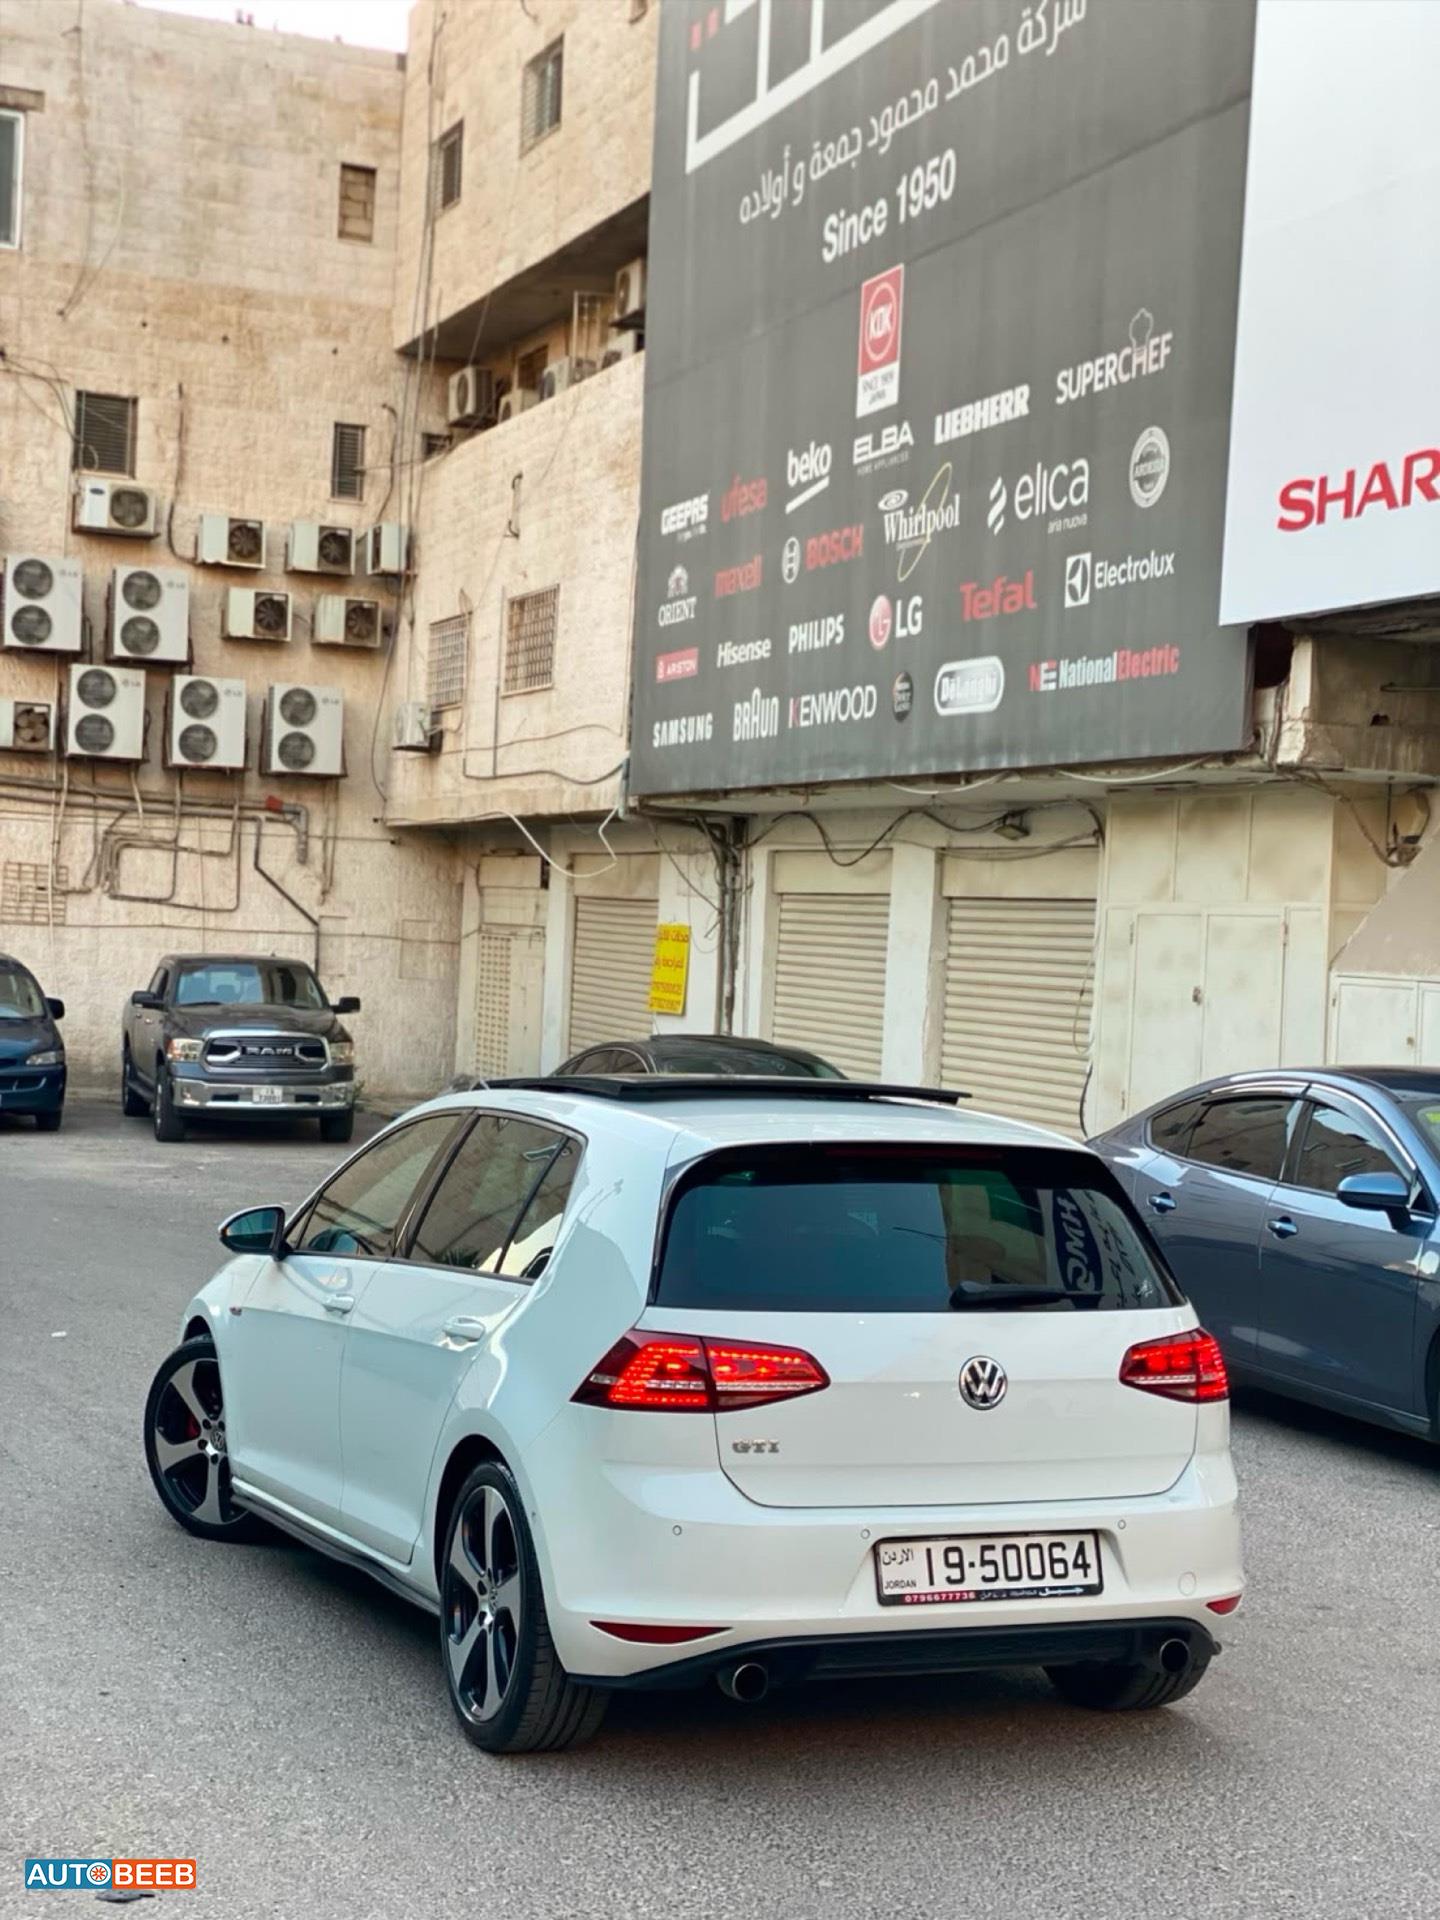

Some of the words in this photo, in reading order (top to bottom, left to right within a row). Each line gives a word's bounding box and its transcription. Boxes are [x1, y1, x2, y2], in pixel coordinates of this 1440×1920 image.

[945, 35, 1009, 101] محمد
[867, 78, 938, 155] محمود
[809, 127, 862, 181] جمعة
[792, 160, 805, 206] و
[822, 197, 888, 263] Since
[896, 148, 957, 224] 1950
[869, 303, 893, 342] KDK
[1055, 331, 1174, 405] SUPERCHEF
[934, 384, 1030, 445] LIEBHERR
[786, 441, 833, 488] beko
[853, 421, 914, 466] ELBA
[1014, 458, 1090, 520] elica
[1277, 448, 1440, 532] SHAR
[883, 492, 961, 545] Whirlpool
[805, 523, 865, 571] BOSCH
[1094, 550, 1176, 590] Electrolux
[714, 554, 763, 598] maxell
[960, 569, 1038, 622] Tefal
[658, 596, 698, 627] ORIENT
[788, 613, 845, 654] PHILIPS
[894, 595, 923, 638] LG
[716, 637, 772, 668] Hisense
[733, 687, 780, 742] BRAUN
[788, 684, 878, 729] KENWOOD
[652, 712, 714, 748] SAMSUNG
[732, 1439, 780, 1453] GTI
[884, 1579, 917, 1589] JORDAN
